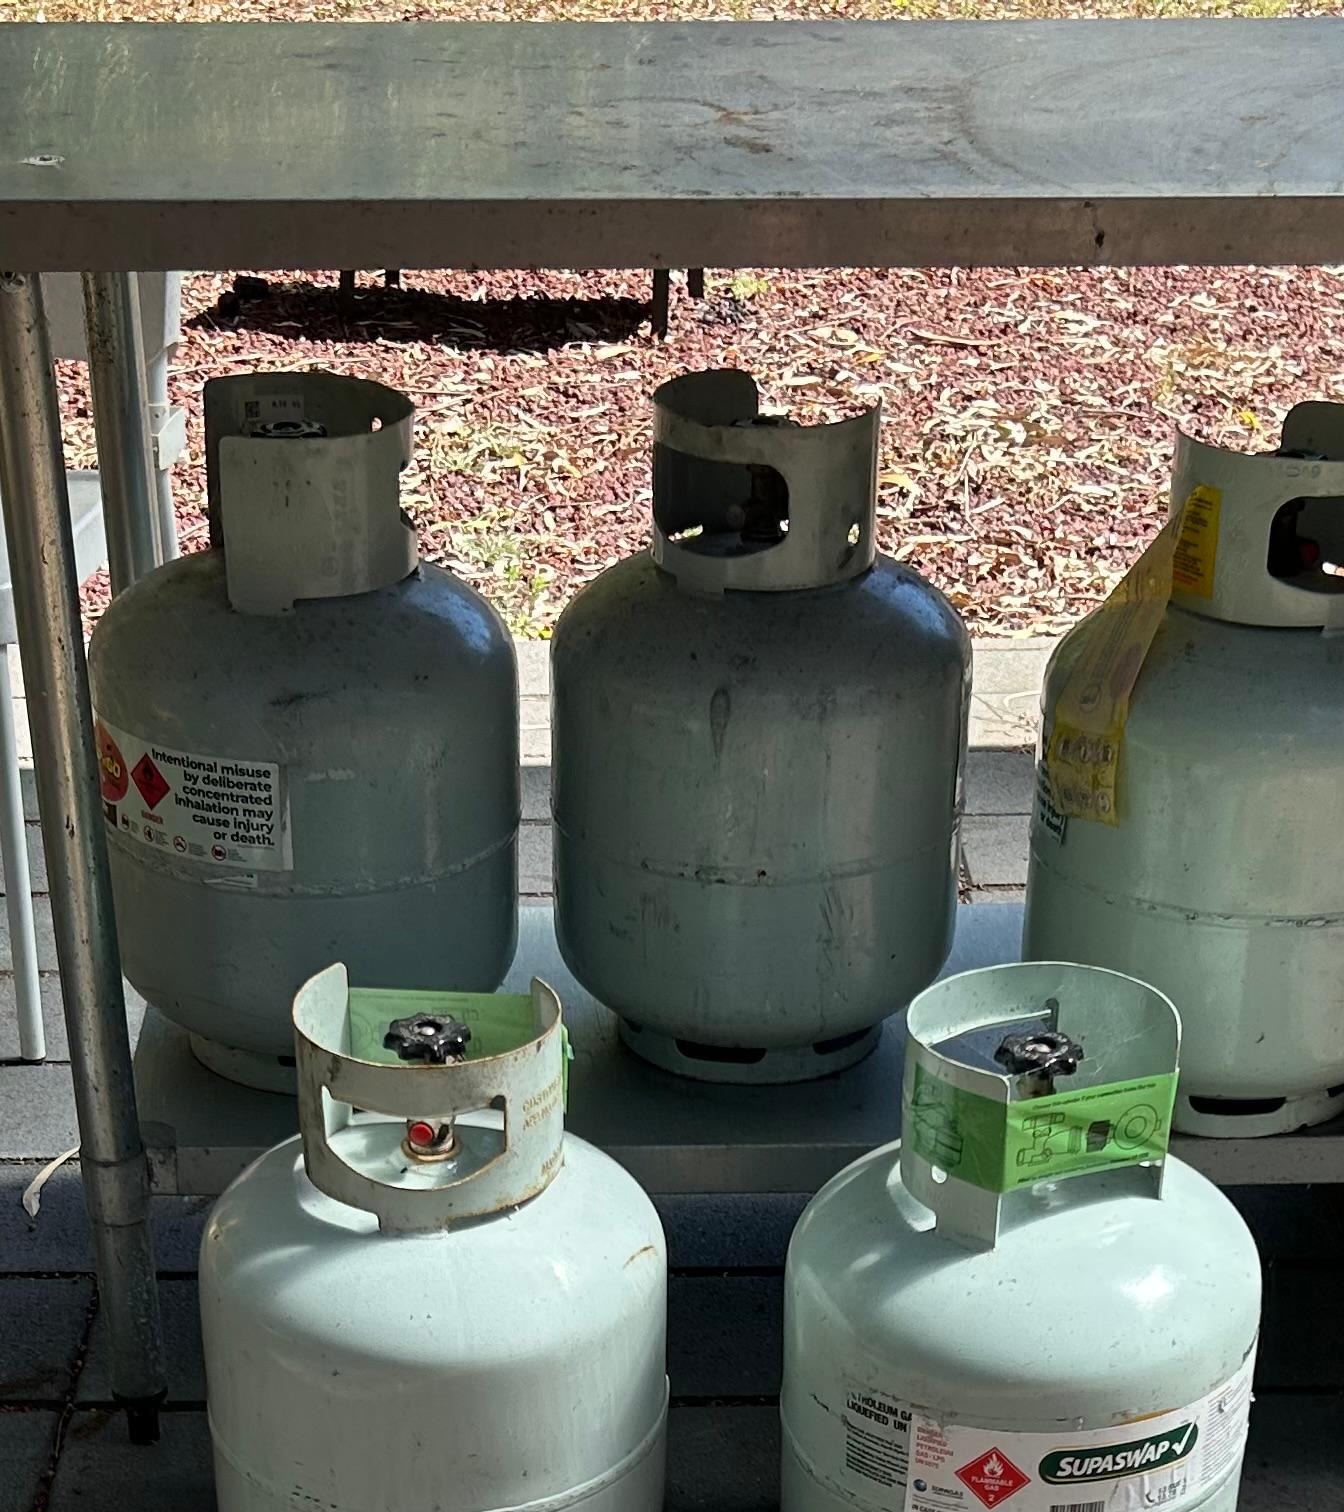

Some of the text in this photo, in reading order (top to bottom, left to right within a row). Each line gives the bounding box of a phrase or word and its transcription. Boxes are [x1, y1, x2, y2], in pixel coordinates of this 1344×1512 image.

[151, 748, 271, 779] Intentional misuse
[183, 770, 272, 792] by deliberate
[182, 785, 273, 806] concentrated
[174, 793, 273, 822] inhalation may
[192, 814, 274, 835] cause injury
[213, 831, 275, 846] or death.
[1056, 1441, 1171, 1477] SUPASWAP
[971, 1475, 1014, 1487] FLAMMABLE
